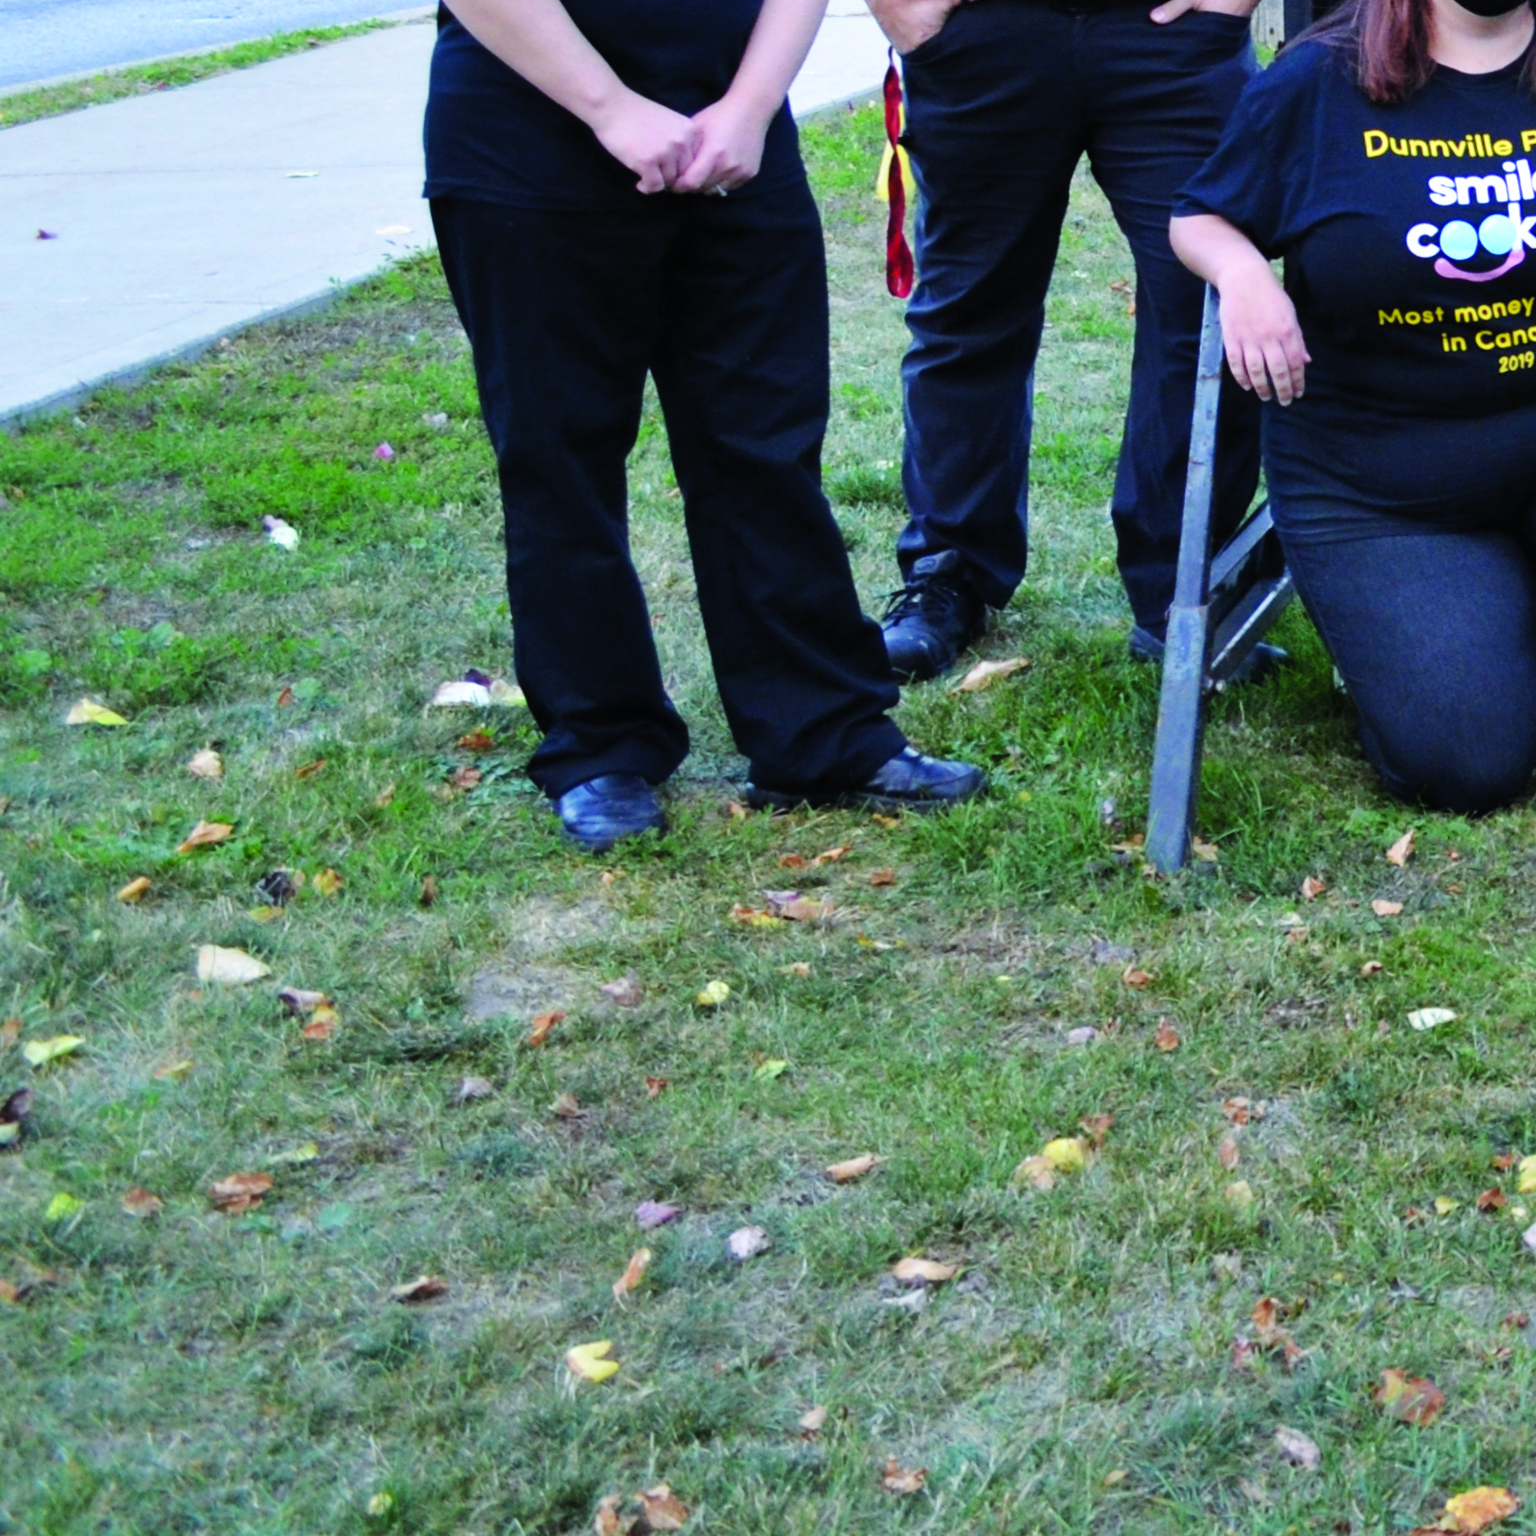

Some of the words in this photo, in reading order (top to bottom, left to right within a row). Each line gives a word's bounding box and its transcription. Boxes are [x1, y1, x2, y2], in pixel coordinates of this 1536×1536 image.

[1363, 129, 1513, 158] Dunnville
[1378, 307, 1444, 325] Most
[1454, 296, 1535, 324] money
[1441, 332, 1467, 352] in
[1498, 351, 1535, 373] 2019
